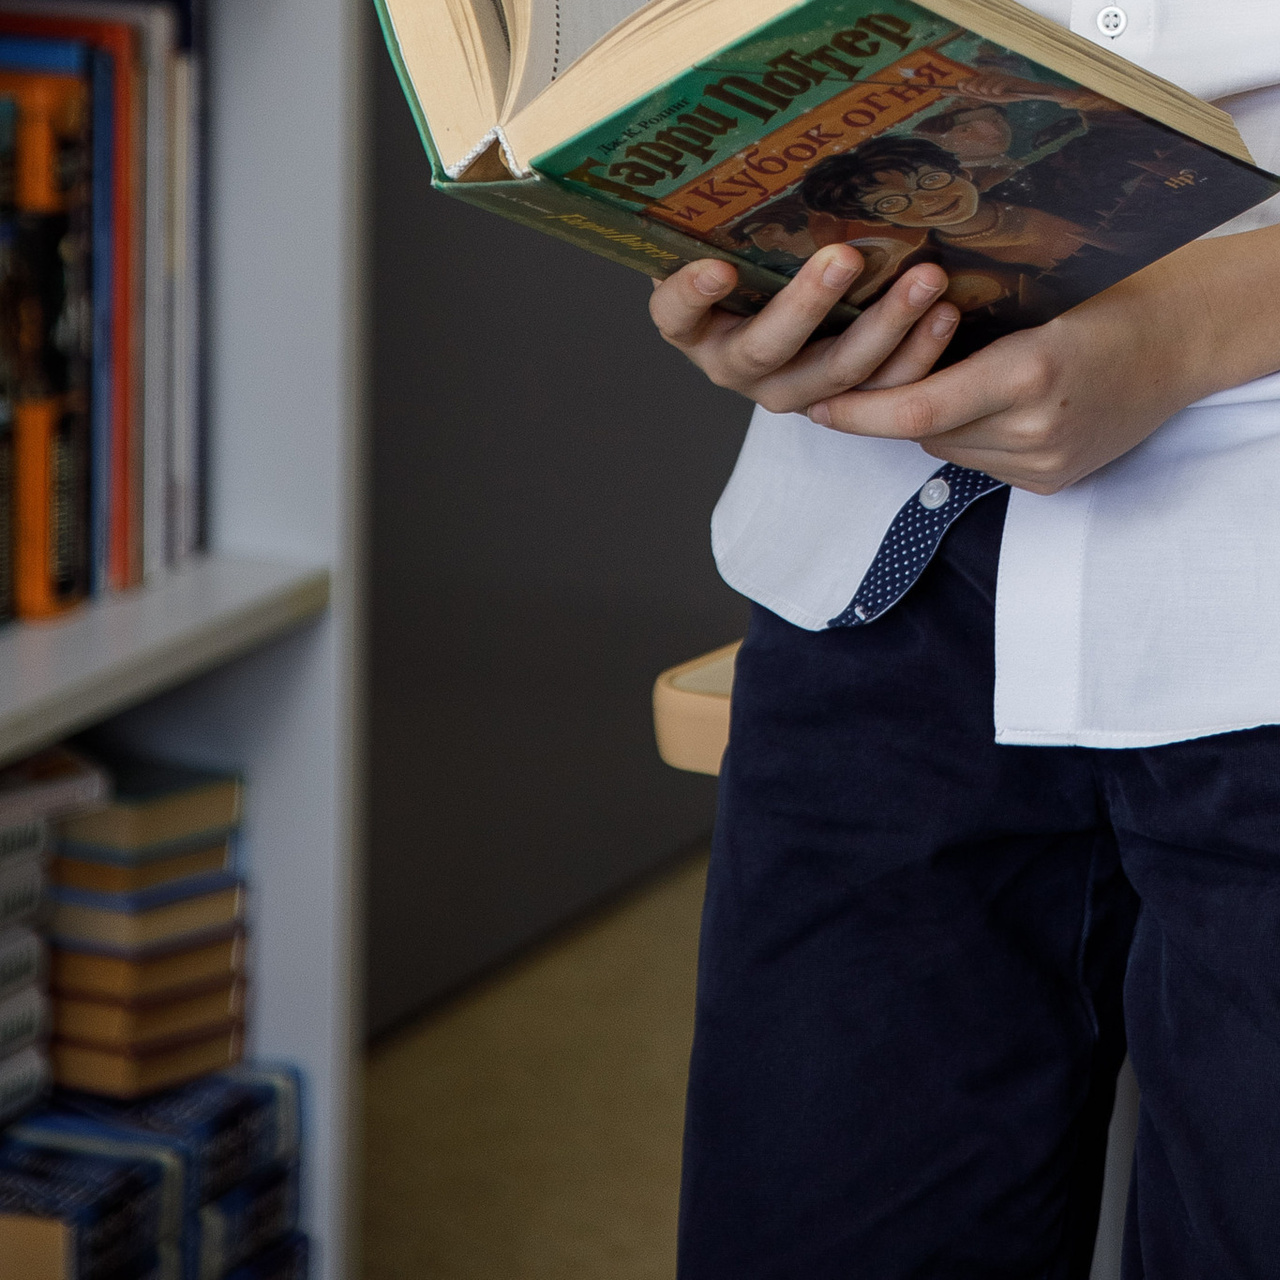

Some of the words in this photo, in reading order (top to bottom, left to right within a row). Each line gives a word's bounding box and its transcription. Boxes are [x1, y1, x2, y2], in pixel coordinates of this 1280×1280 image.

[563, 102, 738, 212] Гарри
[703, 11, 914, 125] Поттер
[638, 96, 691, 133] Ролинг
[689, 116, 845, 210] Кубок
[841, 61, 952, 139] огня
